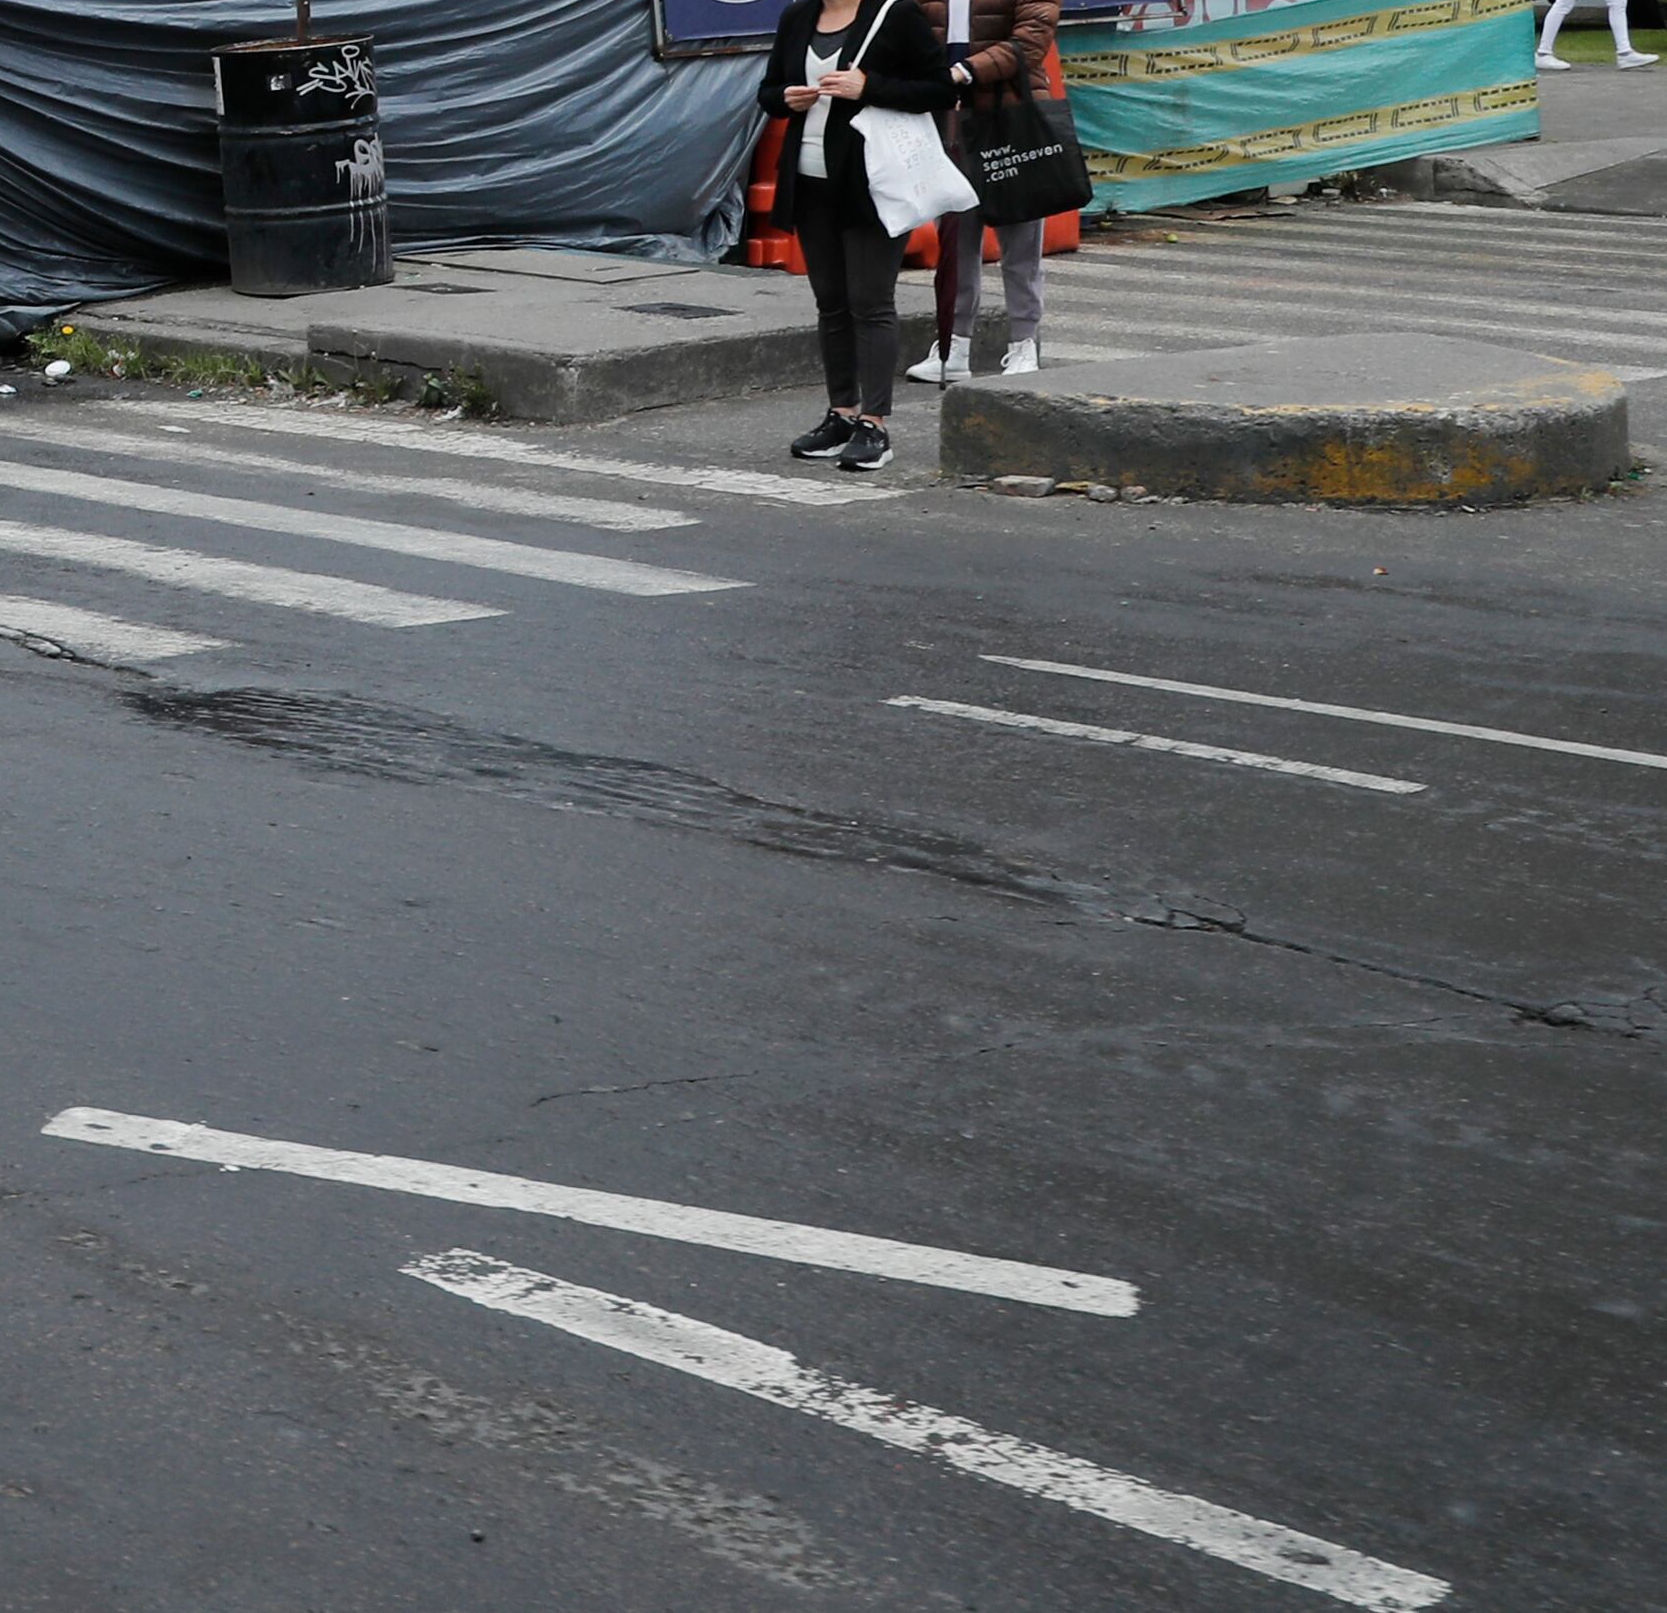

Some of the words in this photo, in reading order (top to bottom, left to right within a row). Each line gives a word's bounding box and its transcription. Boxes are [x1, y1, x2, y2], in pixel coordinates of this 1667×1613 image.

[980, 144, 1016, 159] www.
[983, 144, 1063, 171] sevenseven
[986, 166, 1019, 183] .com
